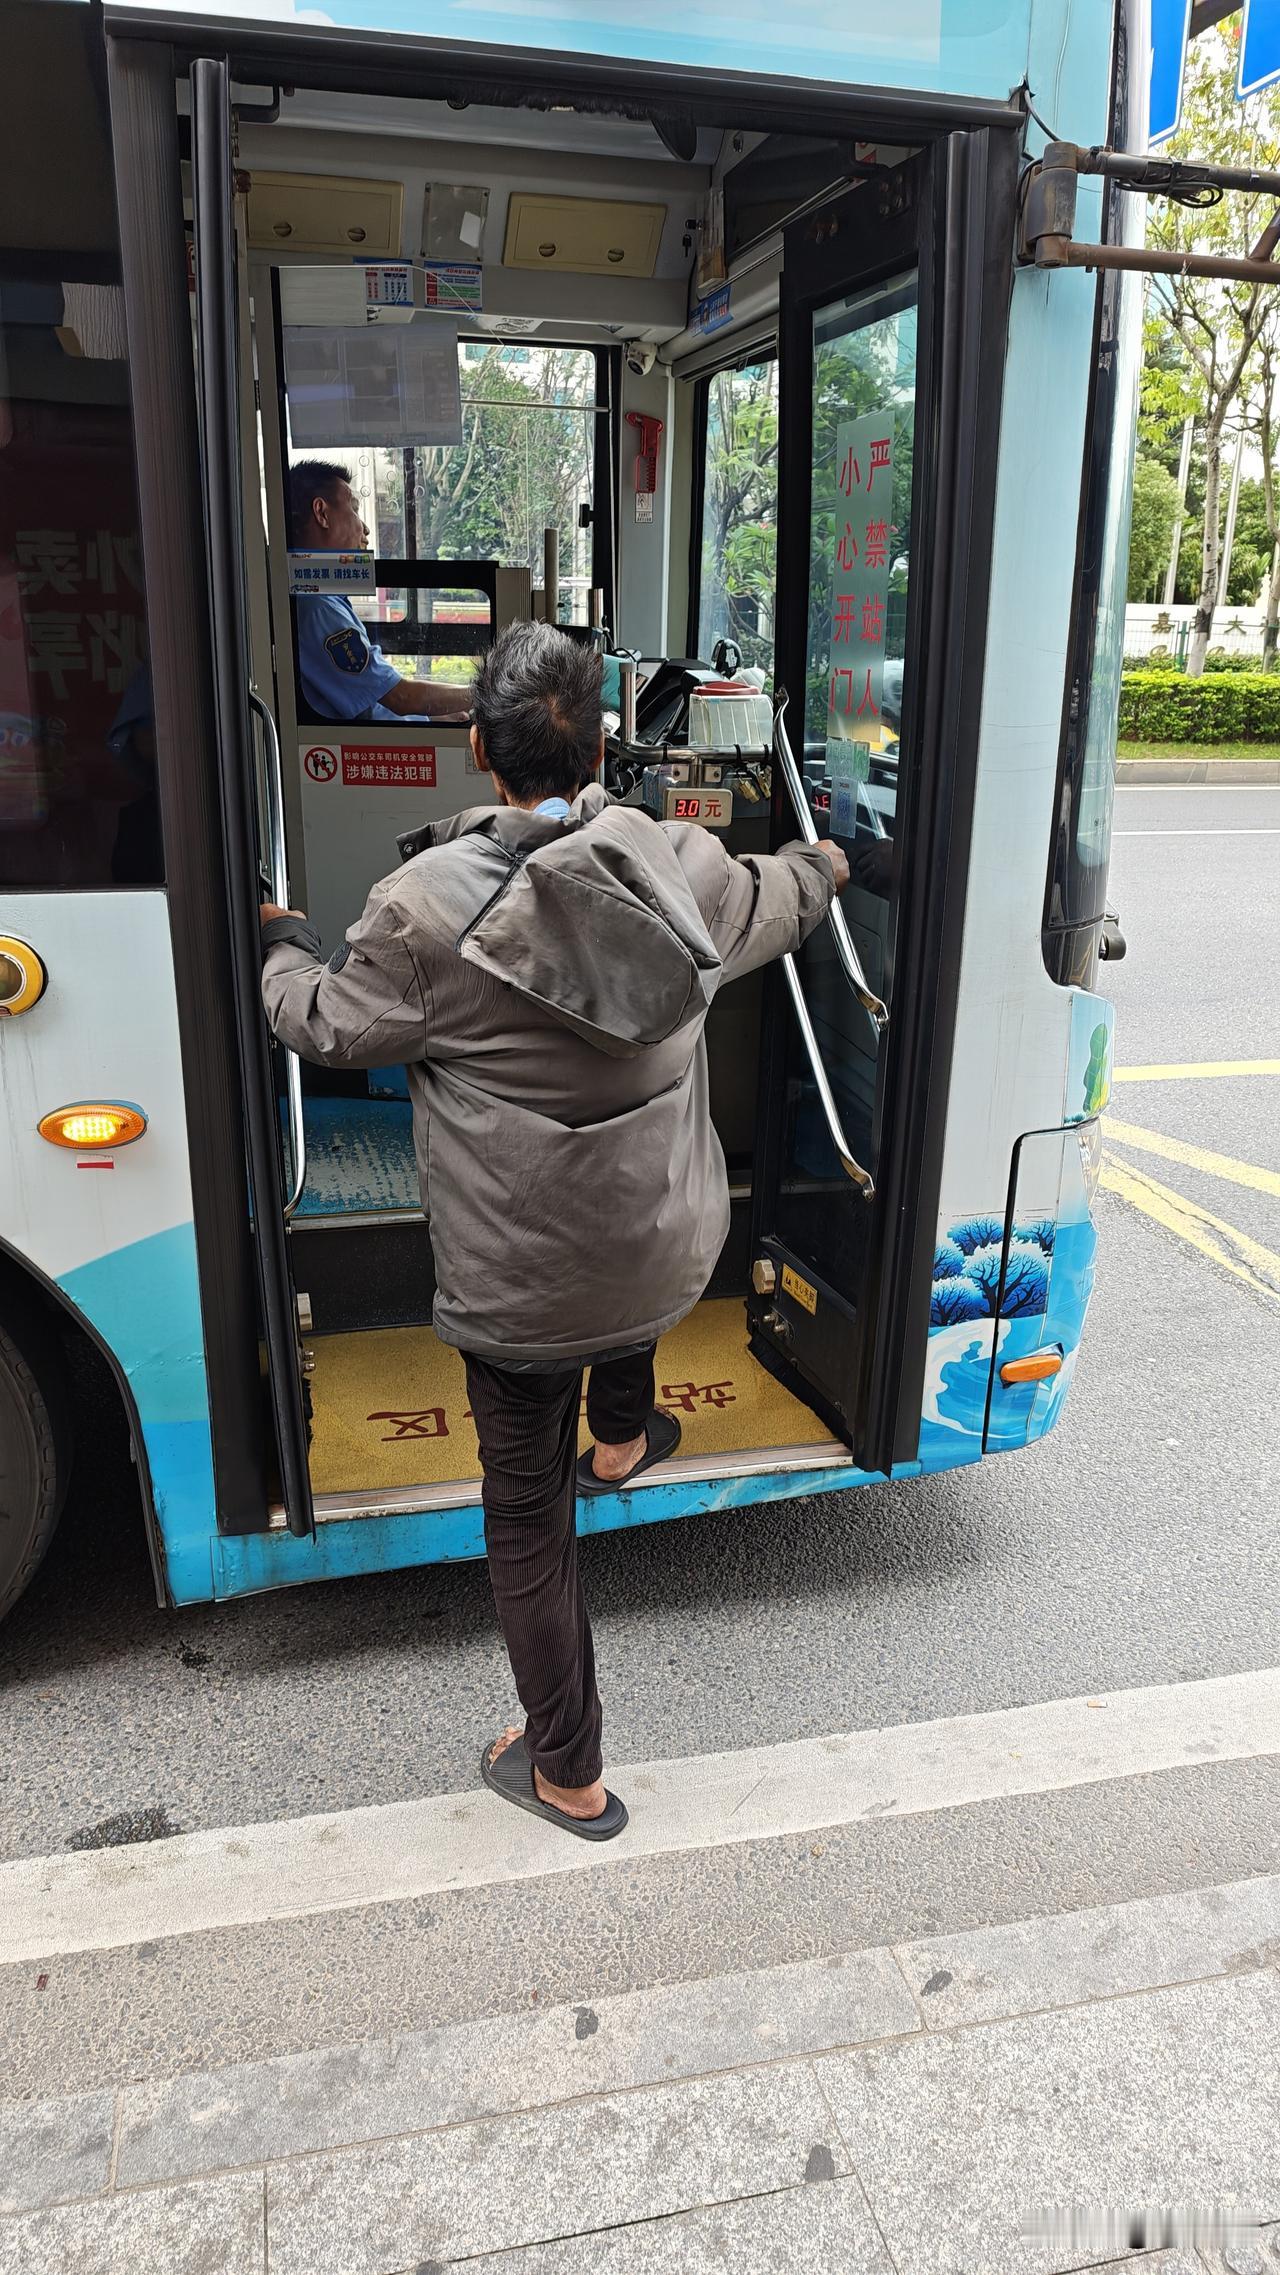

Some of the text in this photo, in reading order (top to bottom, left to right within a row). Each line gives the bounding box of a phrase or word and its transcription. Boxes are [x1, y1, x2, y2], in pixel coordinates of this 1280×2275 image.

[829, 446, 861, 716] 小心开门
[856, 438, 891, 717] 严禁站人
[344, 751, 434, 763] 影响公交车司机安全驾驶
[346, 764, 434, 781] 涉嫌违法犯罪
[676, 799, 722, 818] 3.0 元
